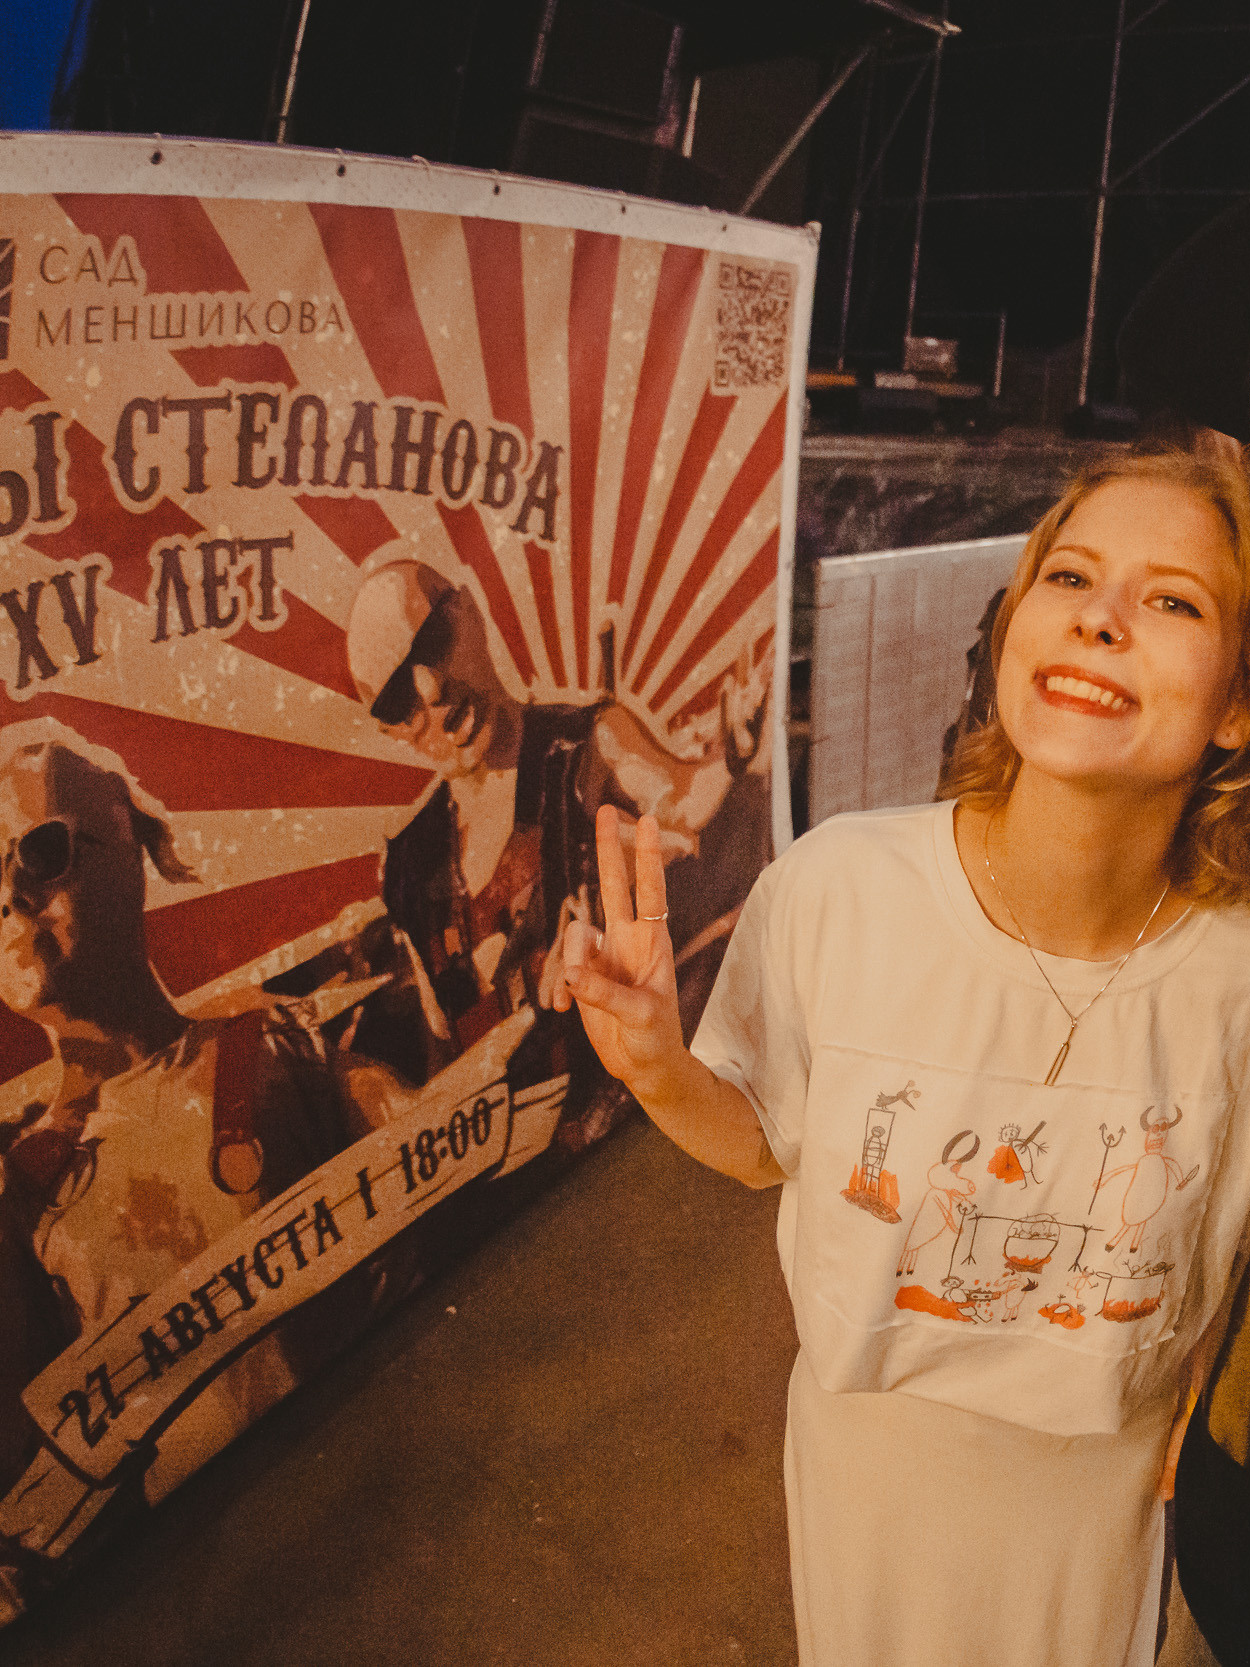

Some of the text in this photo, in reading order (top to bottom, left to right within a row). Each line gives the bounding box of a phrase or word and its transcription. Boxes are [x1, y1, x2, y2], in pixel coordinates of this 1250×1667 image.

[39, 245, 140, 288] САД
[36, 301, 346, 348] МЕНШИКОВА
[111, 389, 564, 541] СТЕПАНОВА
[150, 531, 294, 643] ЛЕТ
[55, 1362, 127, 1449] 27
[138, 1196, 344, 1381] АВГУСТА
[398, 1098, 492, 1194] 18:00
